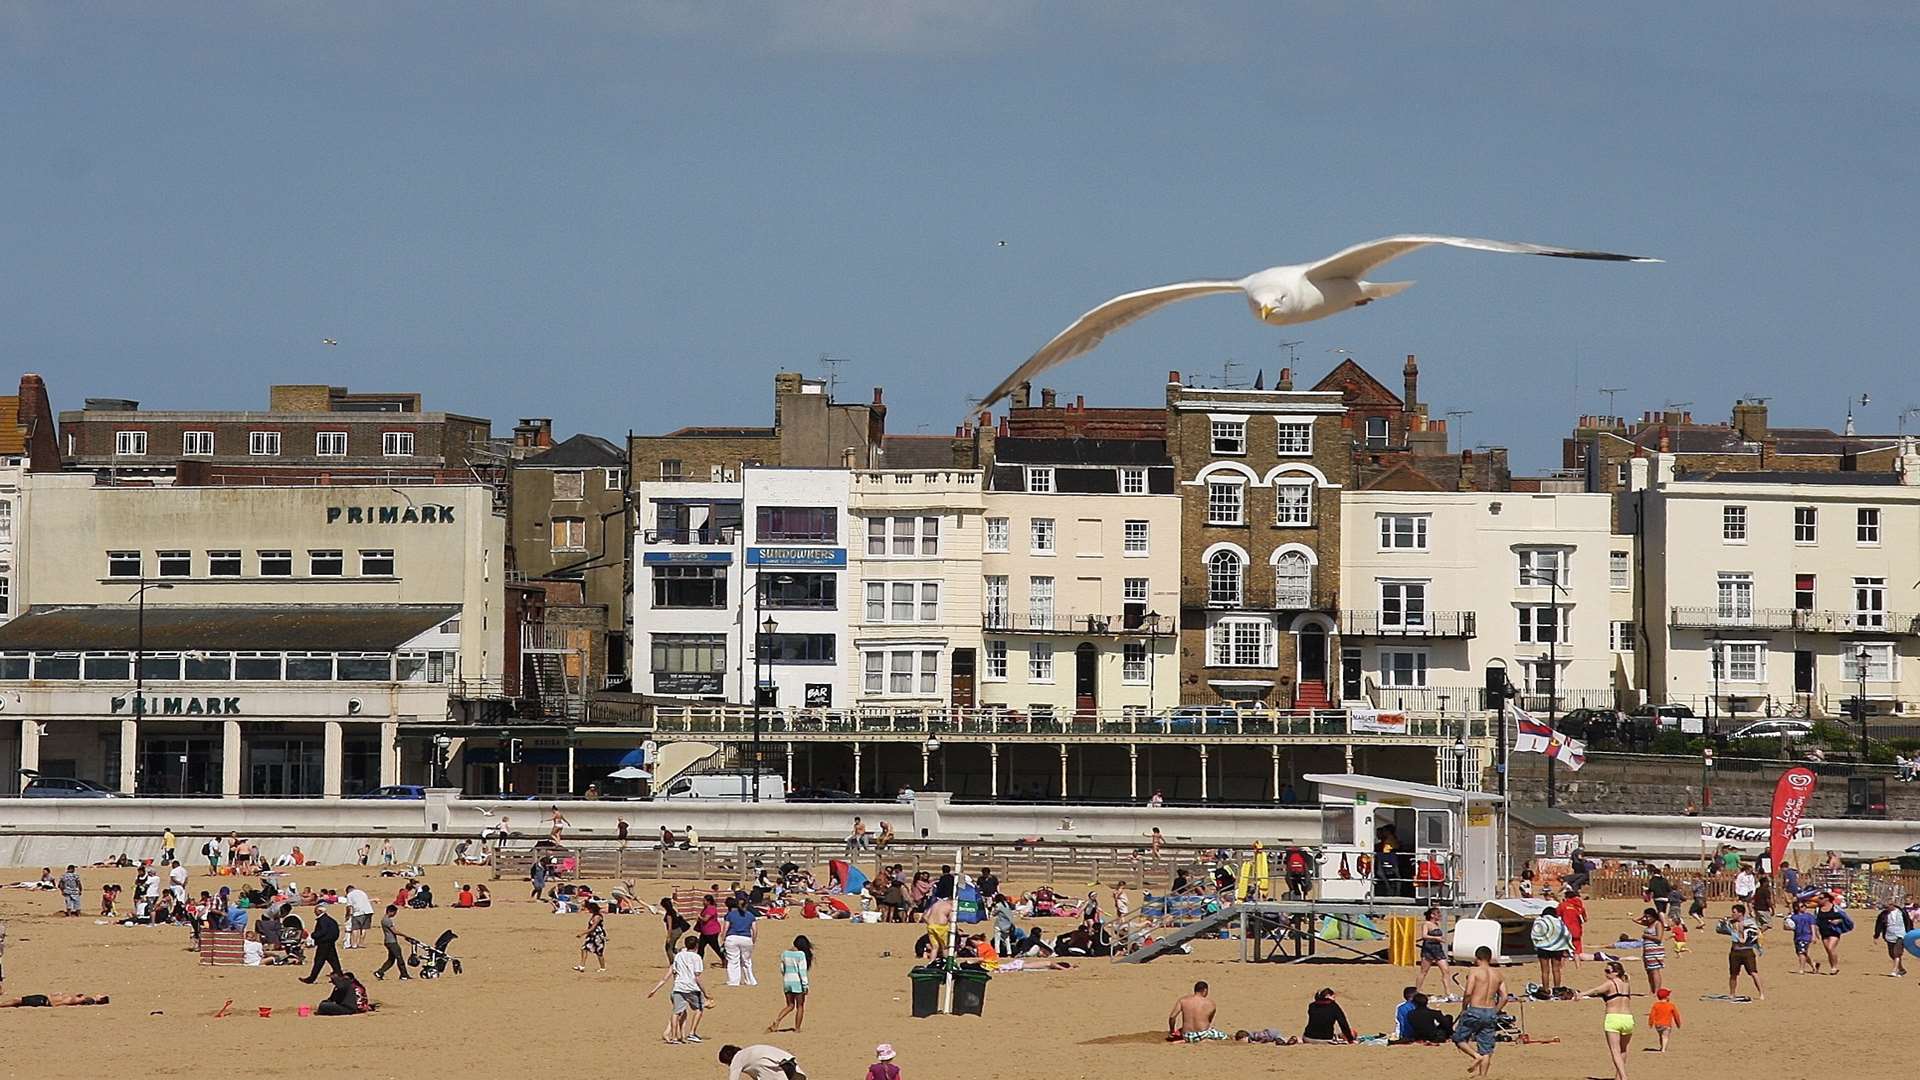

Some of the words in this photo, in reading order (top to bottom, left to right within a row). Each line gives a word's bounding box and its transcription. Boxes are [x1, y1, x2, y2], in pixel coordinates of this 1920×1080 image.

[326, 506, 455, 524] PRIMARK
[760, 549, 835, 559] SUNDOWNERS
[807, 687, 828, 699] BAR
[111, 697, 240, 714] PRIMARK
[1776, 798, 1796, 823] Love
[1715, 826, 1766, 841] BEACH
